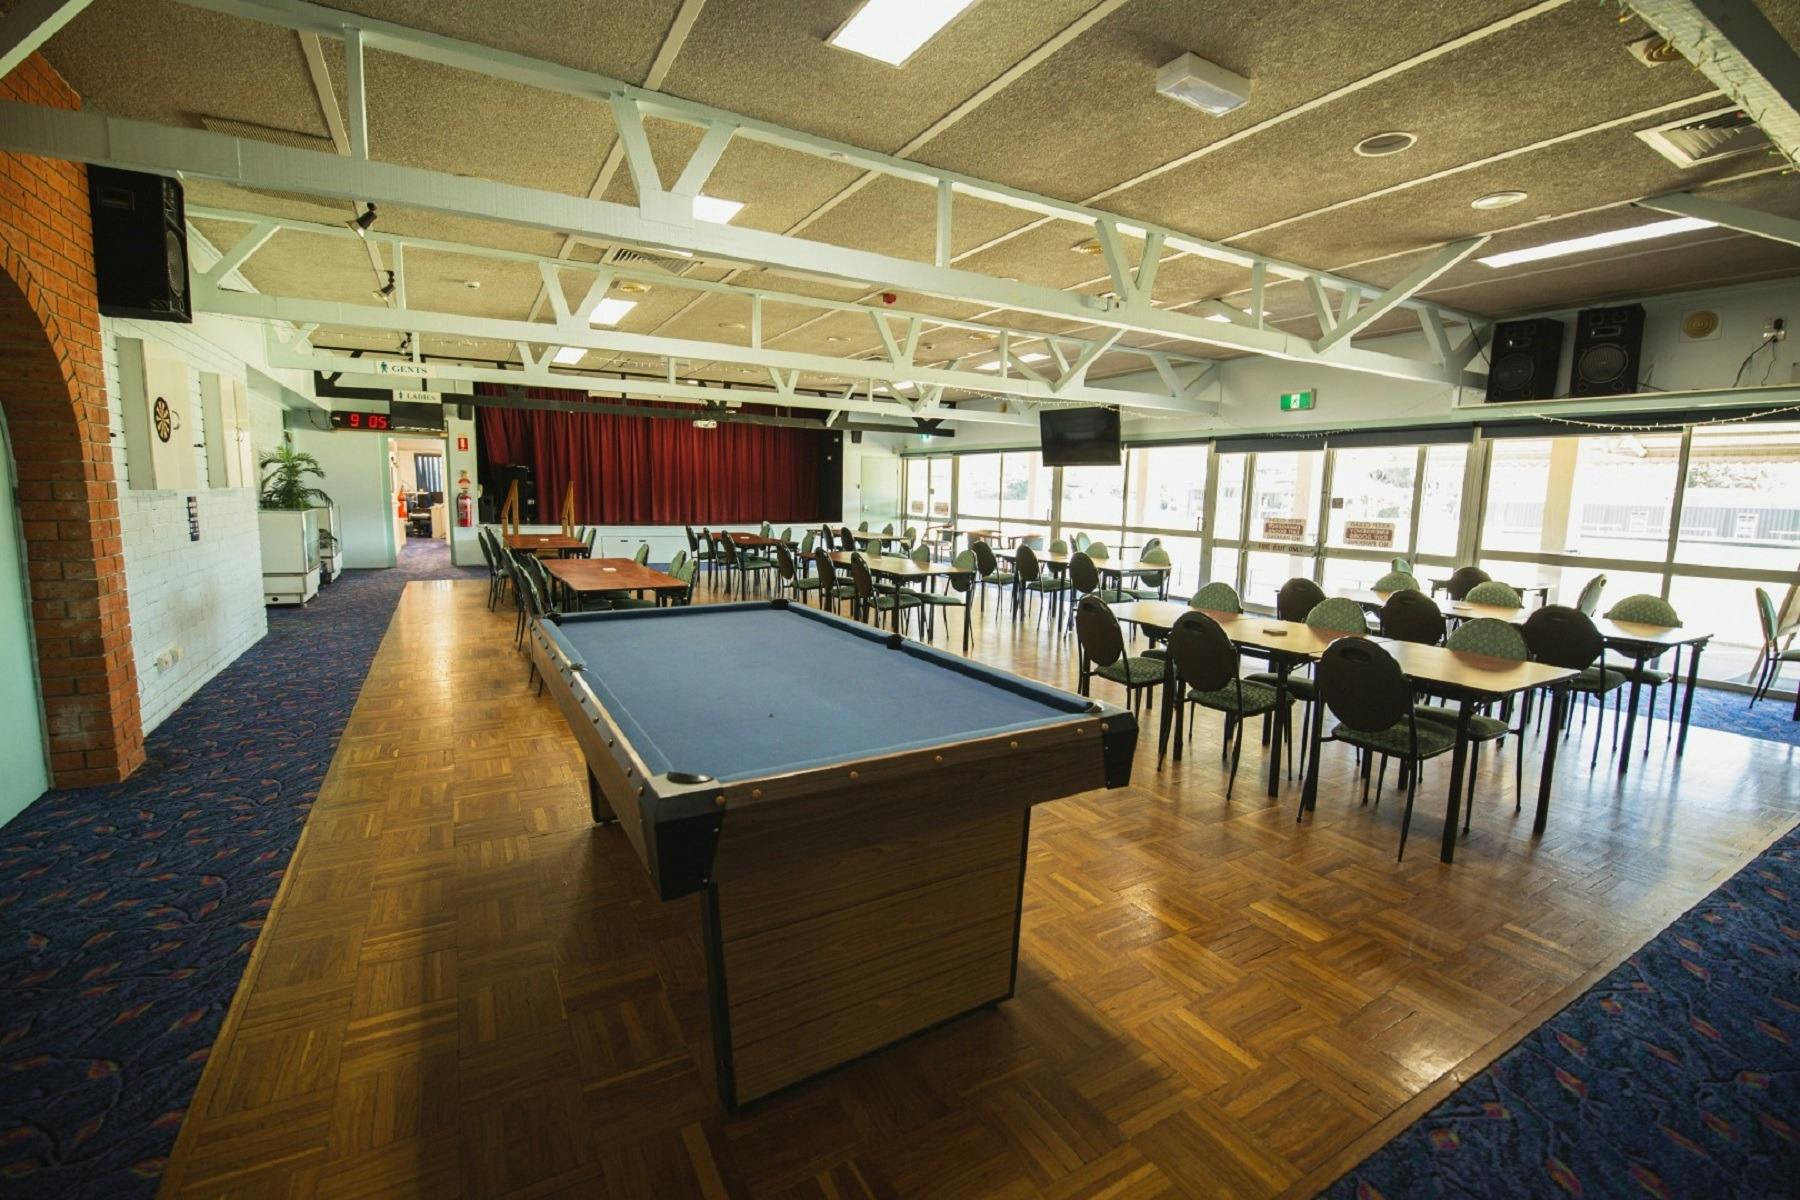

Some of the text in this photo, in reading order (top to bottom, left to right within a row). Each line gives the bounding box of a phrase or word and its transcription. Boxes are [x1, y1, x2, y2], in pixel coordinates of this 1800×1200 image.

[391, 365, 427, 374] GENTS
[407, 392, 436, 401] LADIES
[350, 413, 388, 429] 9 05
